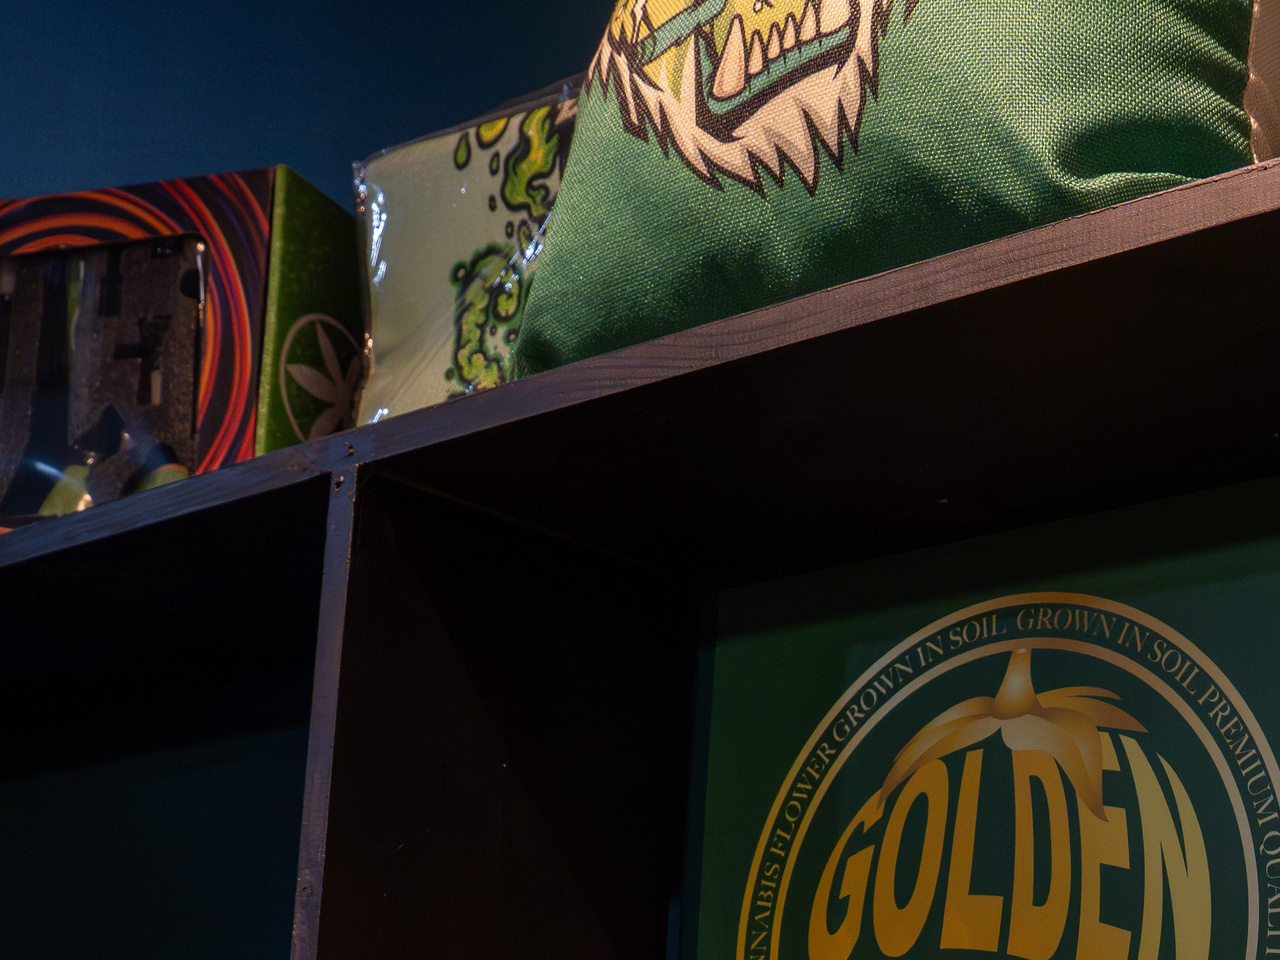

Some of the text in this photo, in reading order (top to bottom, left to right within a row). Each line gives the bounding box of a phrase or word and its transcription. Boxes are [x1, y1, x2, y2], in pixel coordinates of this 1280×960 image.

[770, 741, 836, 858] FLOWER
[832, 654, 914, 744] GROWN
[919, 635, 951, 668] IN
[949, 614, 1007, 651] SOIL
[1017, 606, 1117, 643] GROWN
[1115, 620, 1148, 653] IN
[1146, 639, 1200, 696] SOIL
[1197, 682, 1280, 826] PREMIUM
